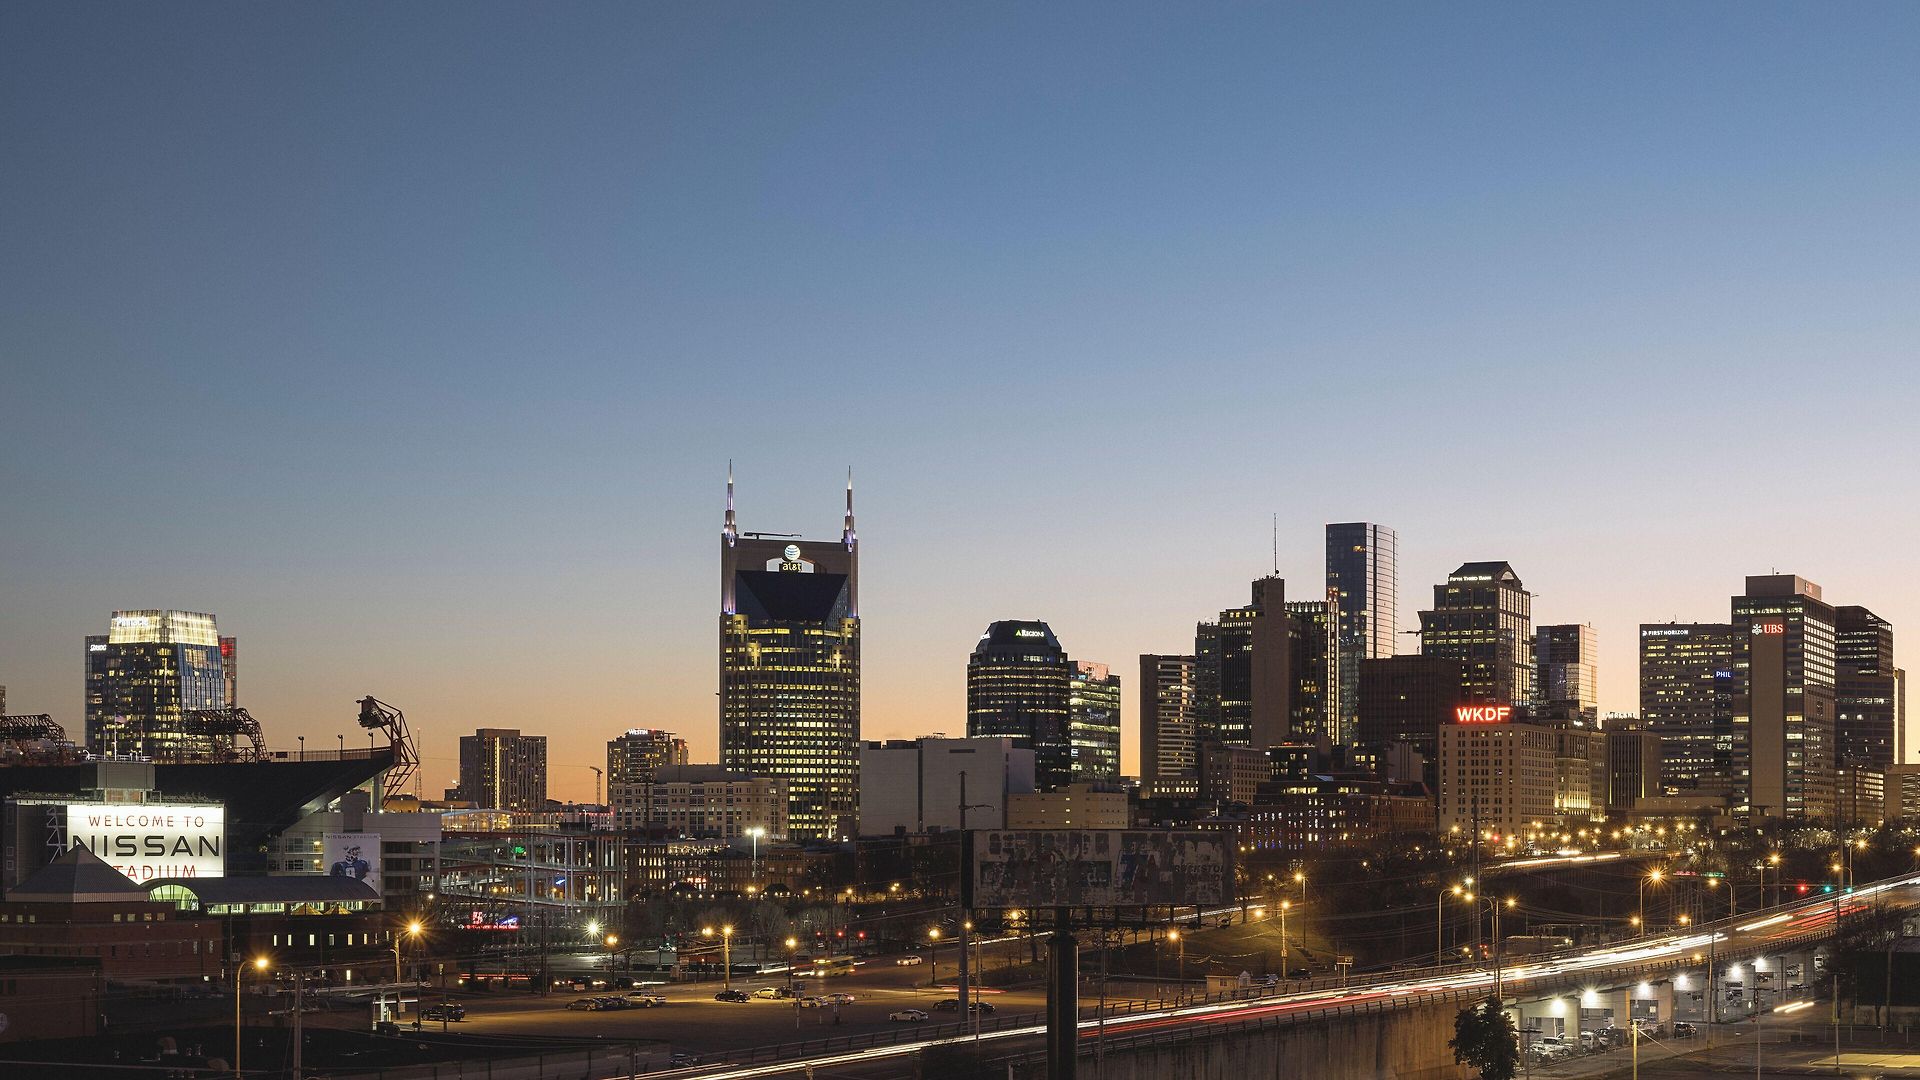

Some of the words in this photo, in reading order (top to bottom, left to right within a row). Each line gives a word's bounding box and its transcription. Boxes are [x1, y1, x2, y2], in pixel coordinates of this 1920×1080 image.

[782, 562, 802, 571] at&t
[1763, 624, 1784, 634] UBS
[1457, 707, 1511, 721] WKDF
[88, 815, 174, 828] WELCOME
[184, 816, 205, 828] TO
[72, 835, 220, 857] NISSAN
[112, 864, 197, 880] TADIUM
